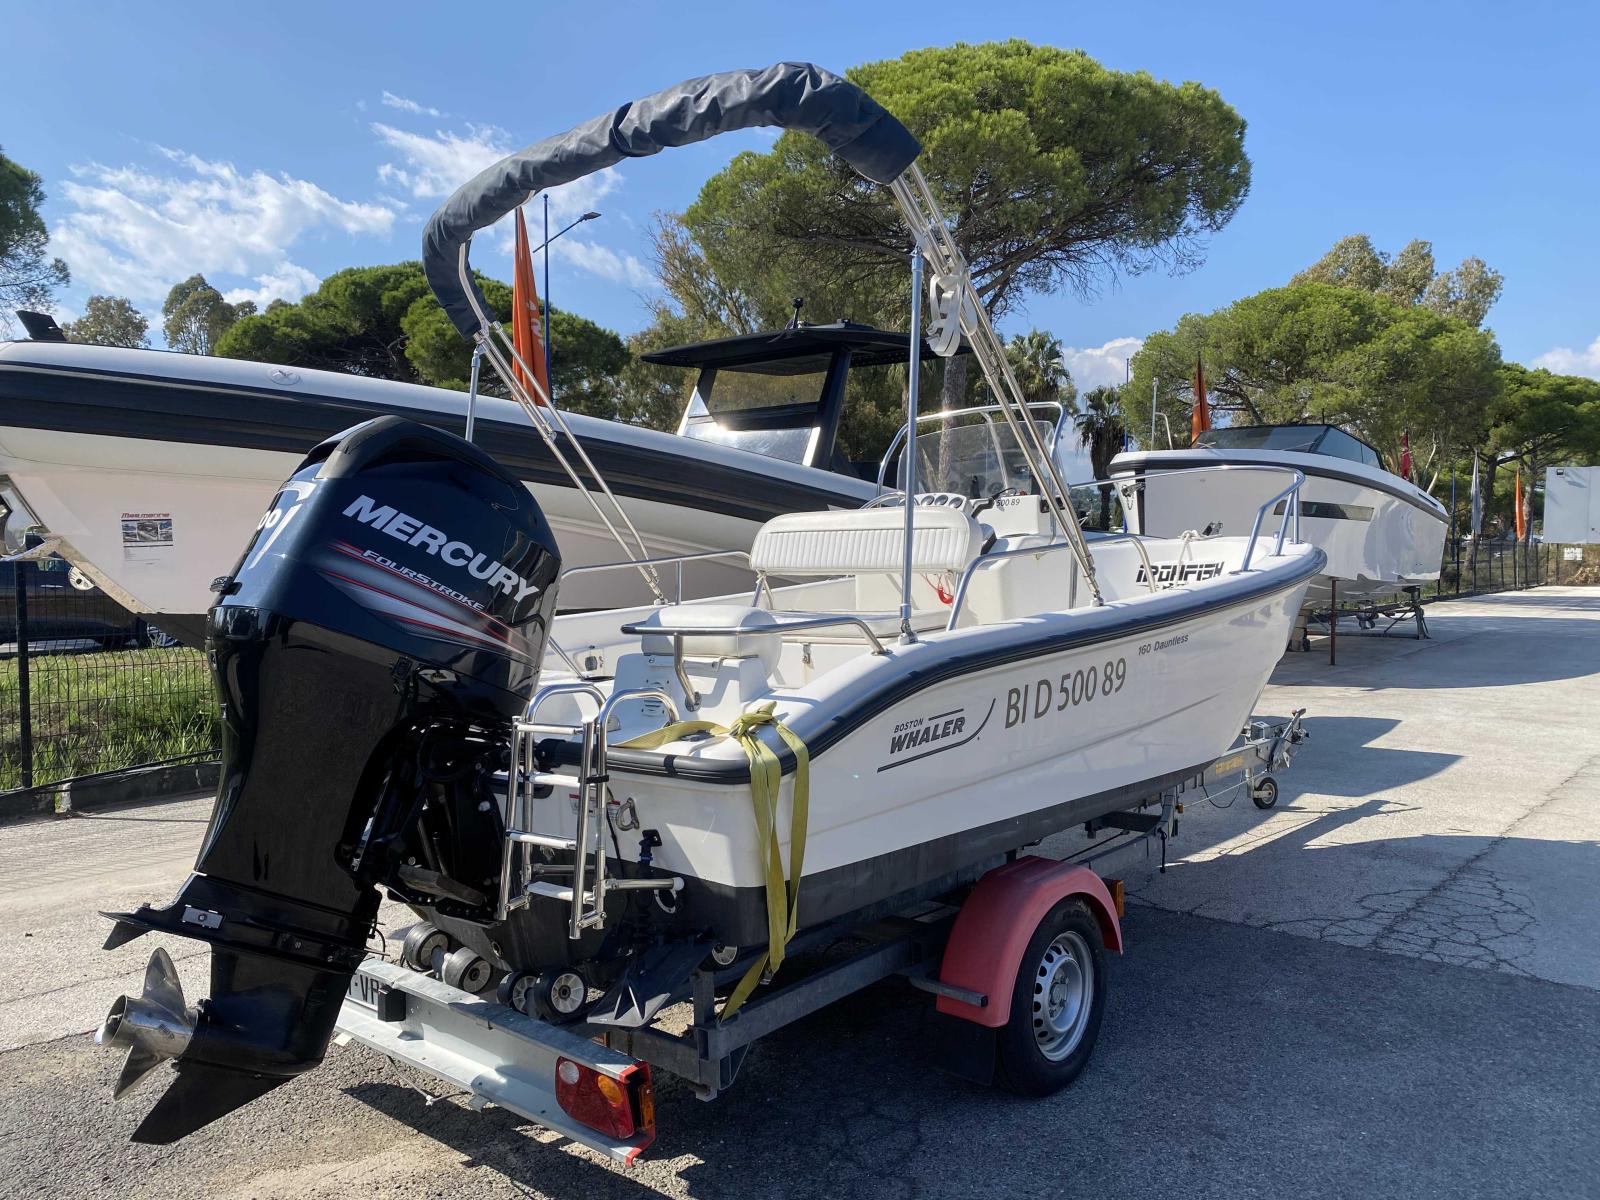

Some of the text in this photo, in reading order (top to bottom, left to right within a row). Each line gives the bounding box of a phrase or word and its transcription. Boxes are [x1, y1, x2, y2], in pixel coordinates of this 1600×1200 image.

[1011, 498, 1021, 506] 89
[342, 495, 539, 603] MERCURY
[361, 549, 486, 611] FOURSTROKE
[1138, 635, 1189, 656] 160 Dauntless
[1057, 665, 1098, 711] 500
[1101, 657, 1127, 697] 89
[889, 715, 967, 755] WHALER
[893, 717, 925, 733] BOSTON
